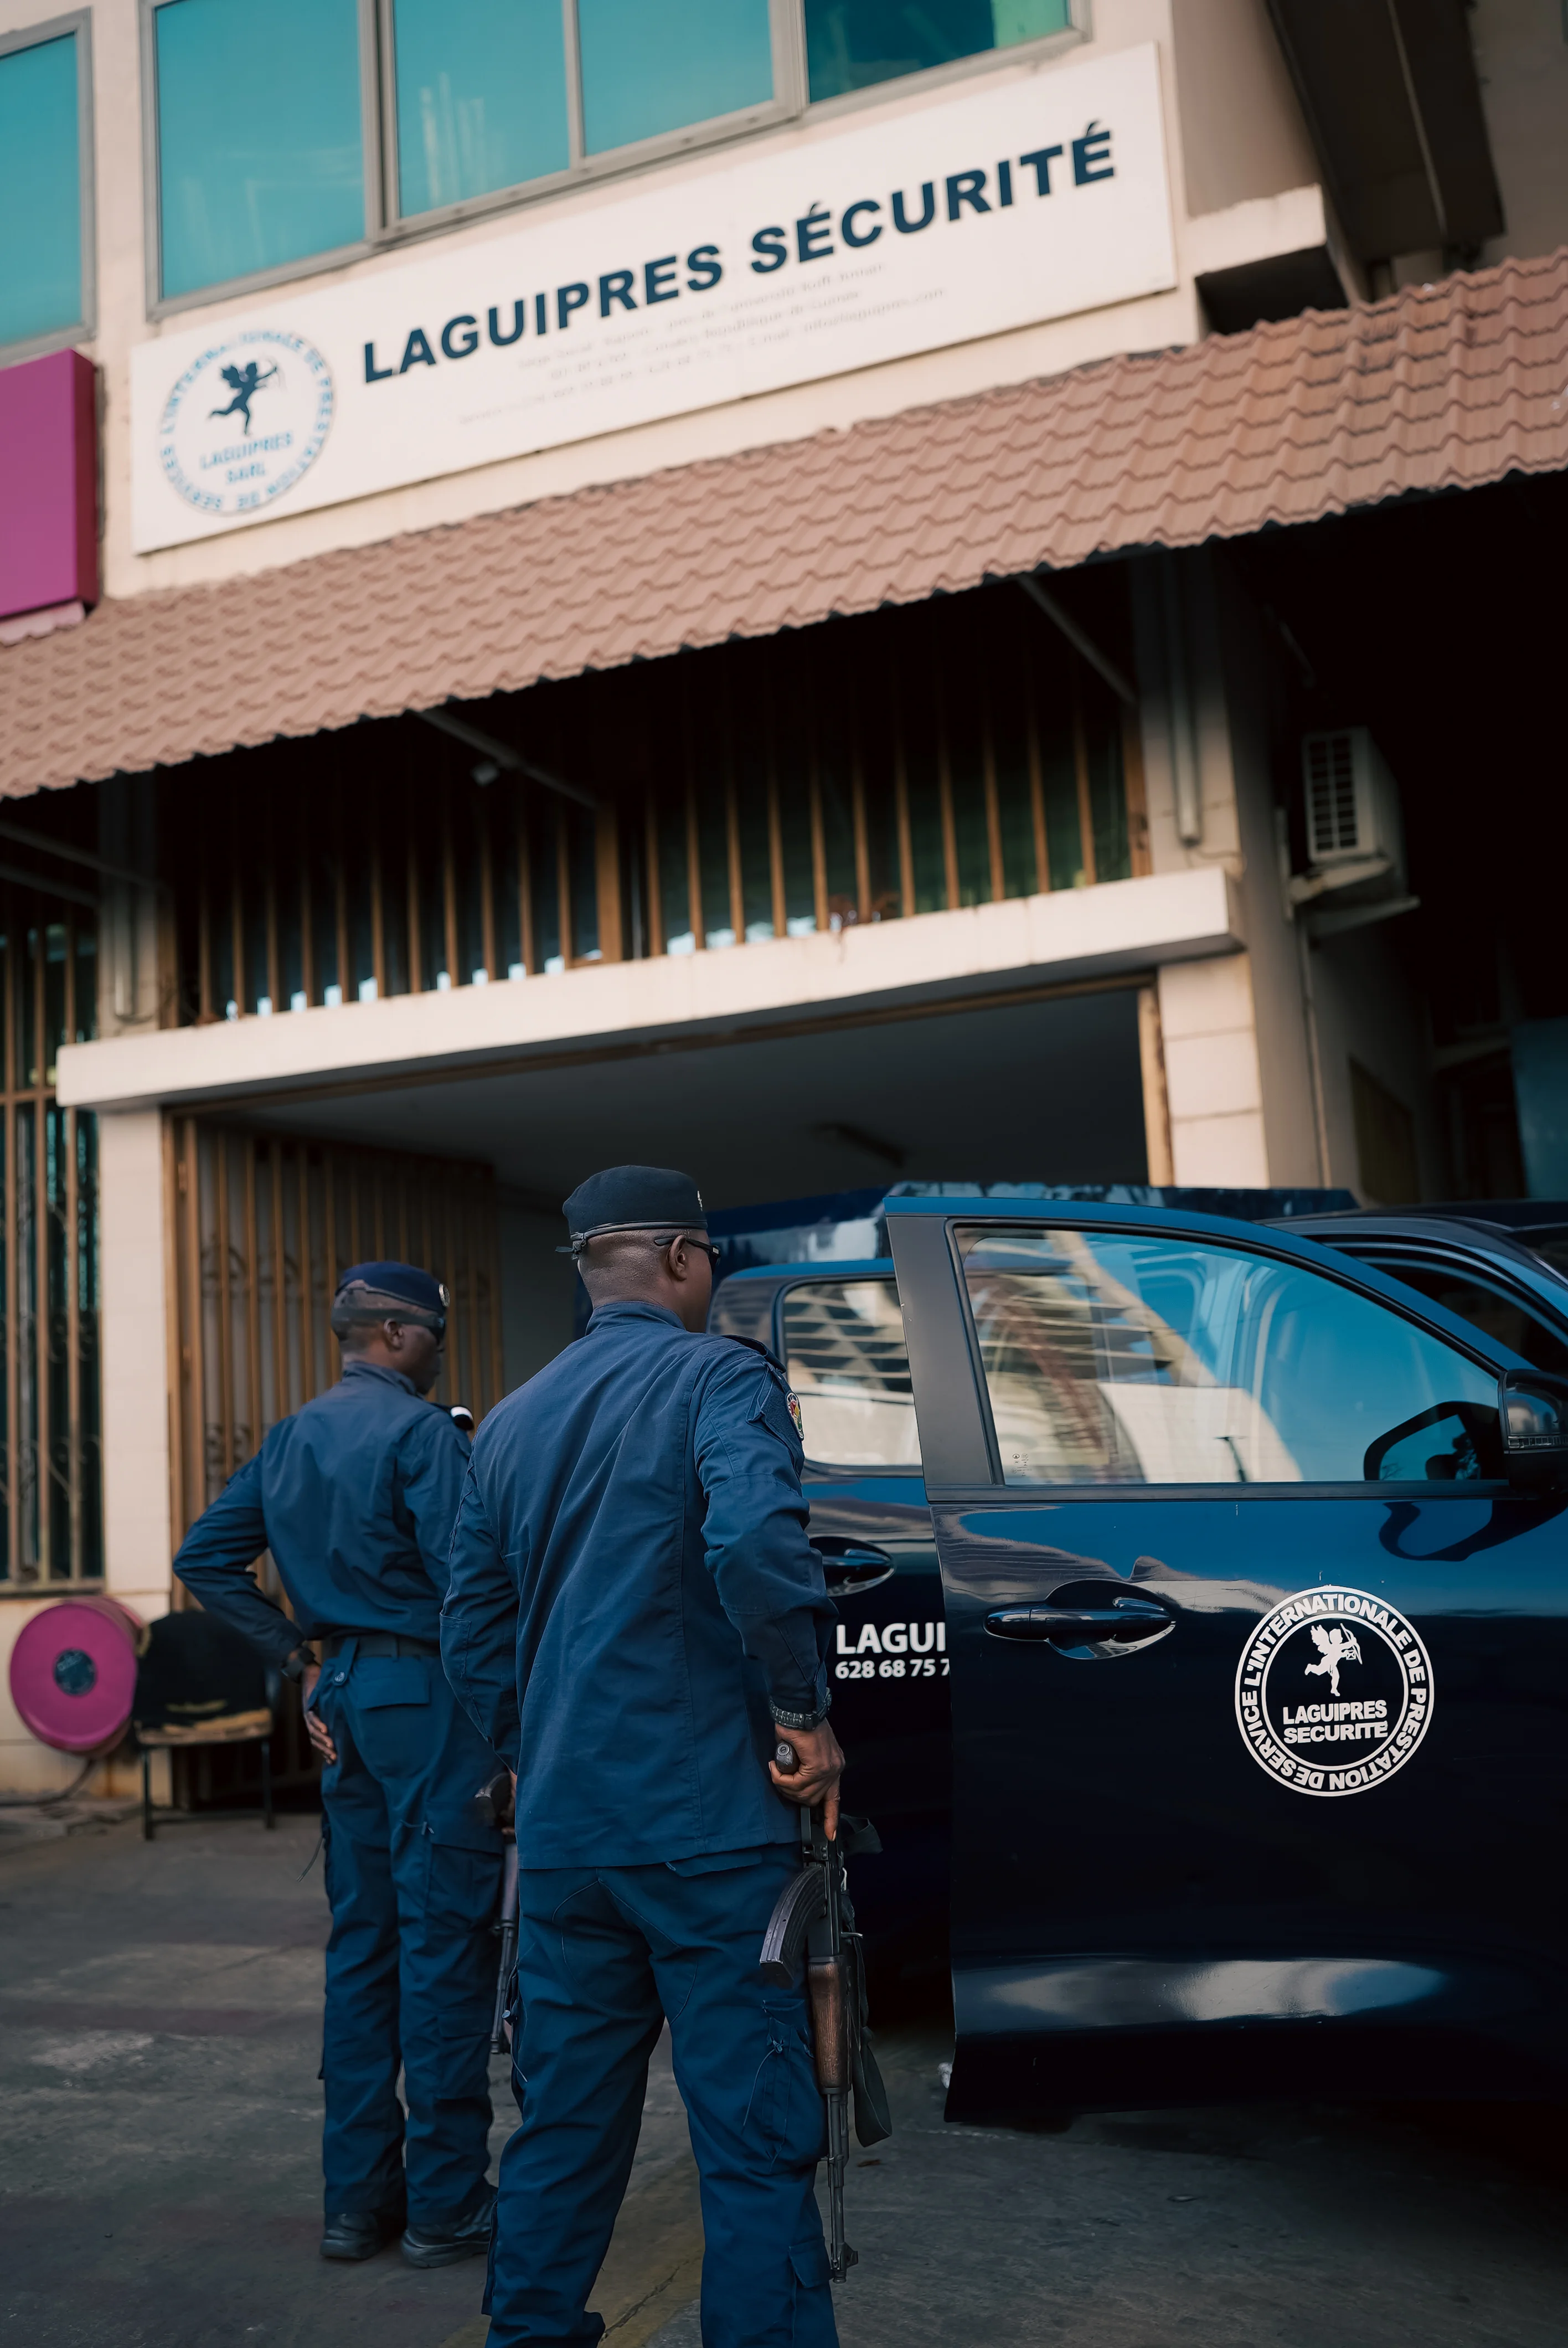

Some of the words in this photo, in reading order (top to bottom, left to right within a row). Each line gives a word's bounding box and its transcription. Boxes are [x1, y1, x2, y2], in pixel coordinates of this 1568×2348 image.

[364, 244, 724, 384] LAGUIPRES
[751, 120, 1115, 274] SÉCURITÉ
[837, 1622, 946, 1655] LAGUI
[1244, 1593, 1412, 1686] L'INTERNATIONALE
[835, 1660, 876, 1679] 628
[879, 1659, 906, 1678] 68
[910, 1658, 936, 1677] 75
[941, 1658, 950, 1676] 7
[1403, 1649, 1426, 1683] DE
[1283, 1700, 1388, 1725] LAGUIPRES
[1329, 1688, 1427, 1790] PRESTATION
